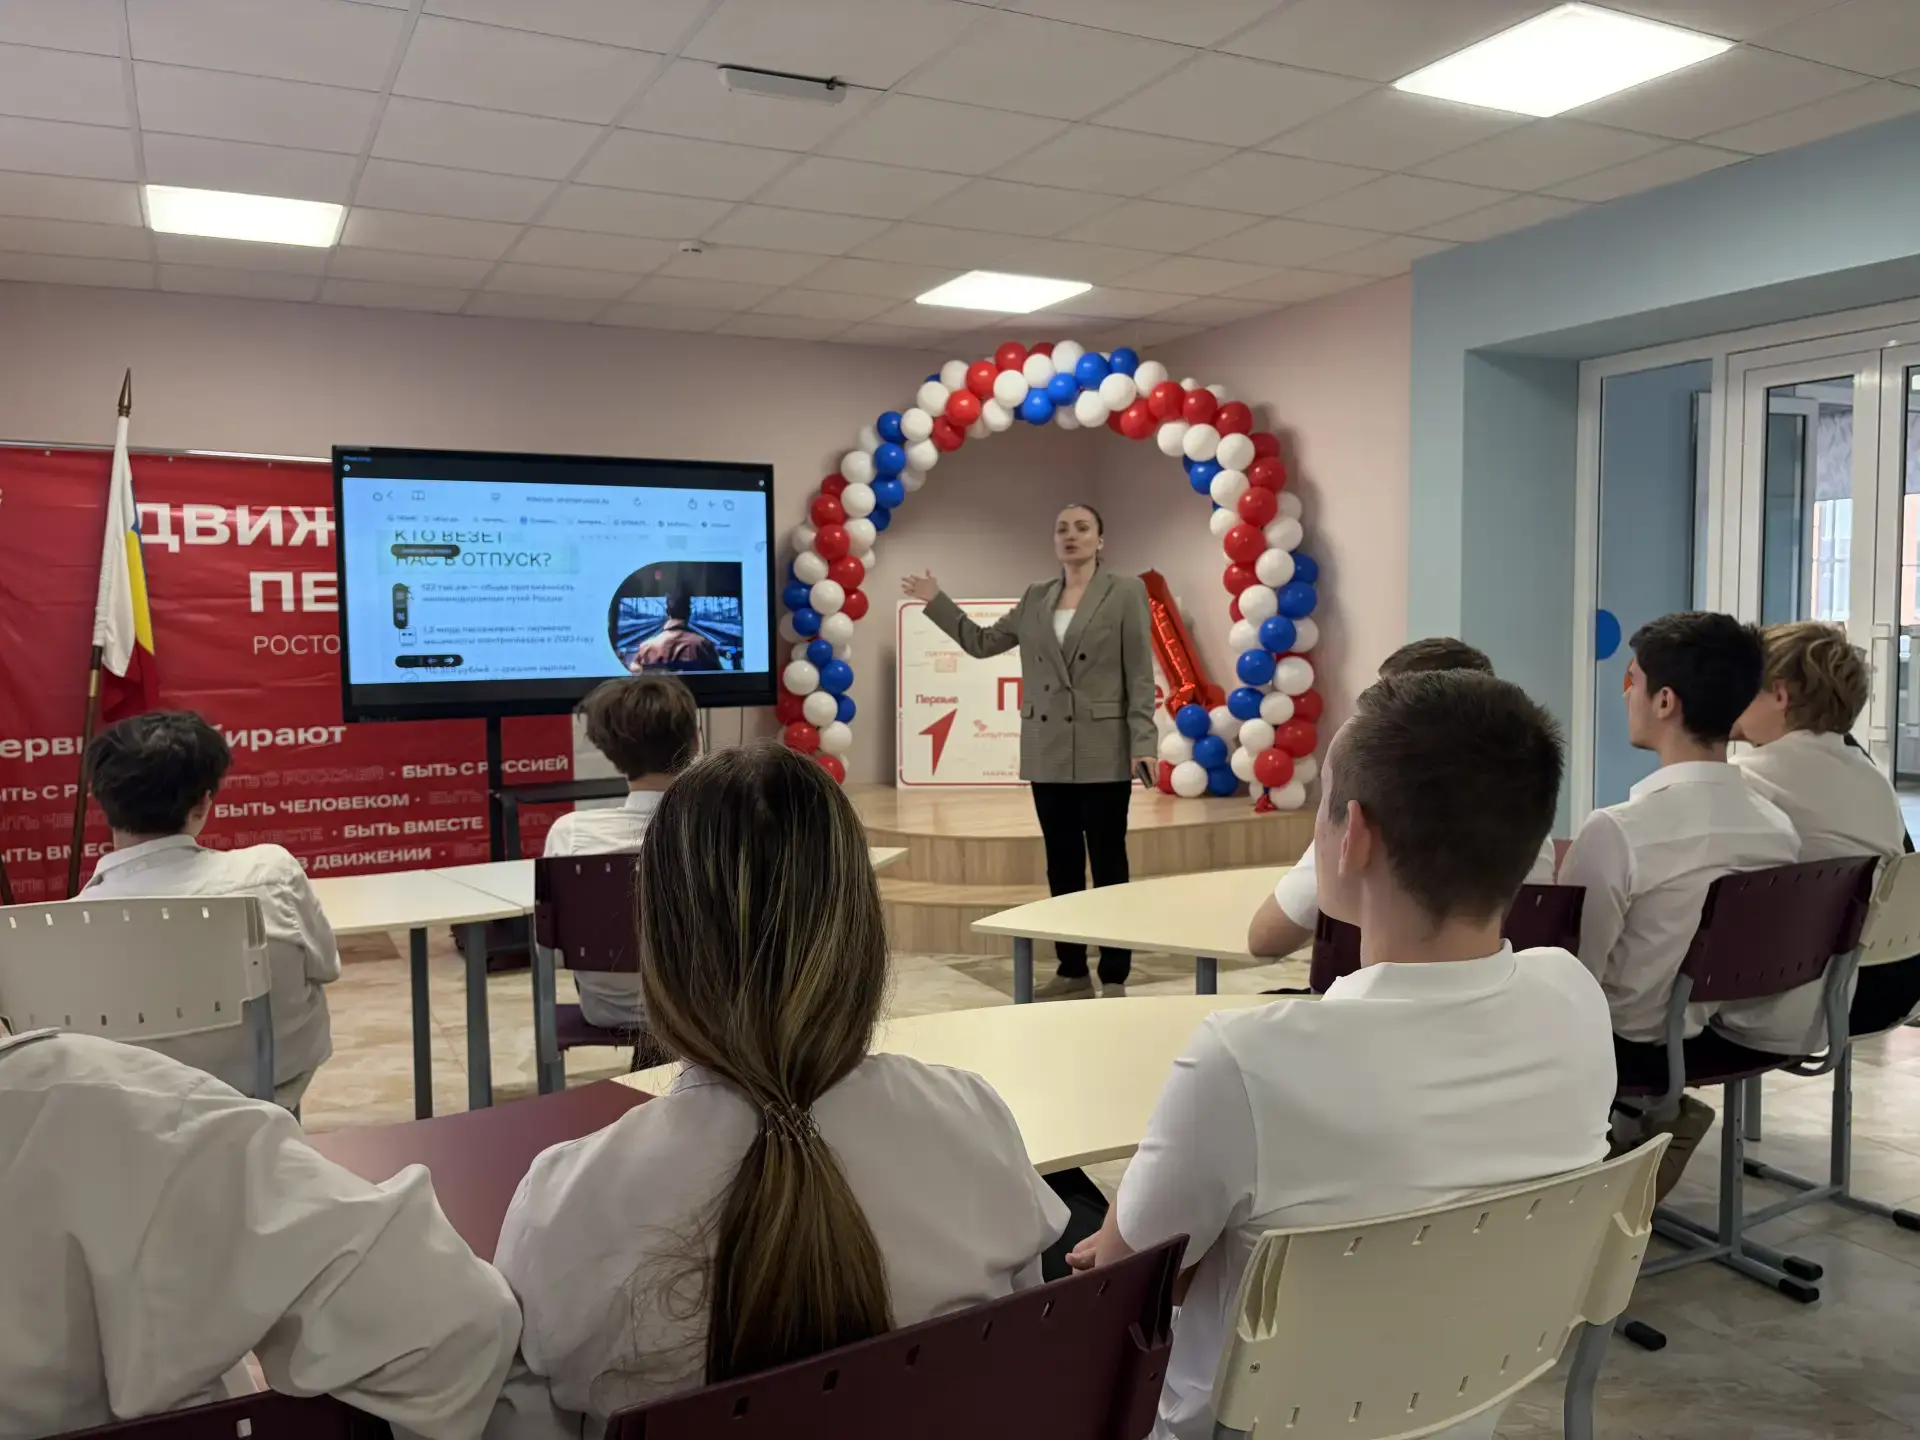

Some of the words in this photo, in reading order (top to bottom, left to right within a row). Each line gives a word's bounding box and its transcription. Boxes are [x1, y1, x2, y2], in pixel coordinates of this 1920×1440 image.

[462, 552, 551, 567] ОТПУСК?
[253, 634, 341, 655] РОСТО
[916, 694, 959, 707] Первые
[0, 735, 83, 763] ерв
[403, 764, 457, 780] БЫТЬ
[461, 762, 476, 776] С
[478, 755, 569, 776] РССИЕЙ
[215, 801, 276, 818] БЫТЬ
[280, 794, 410, 814] ЧЕЛОВЕКОМ
[344, 822, 400, 838] БЫТЬ
[403, 816, 483, 834] ВМЕСТЕ
[313, 847, 431, 870] ДВИЖЕНИИ
